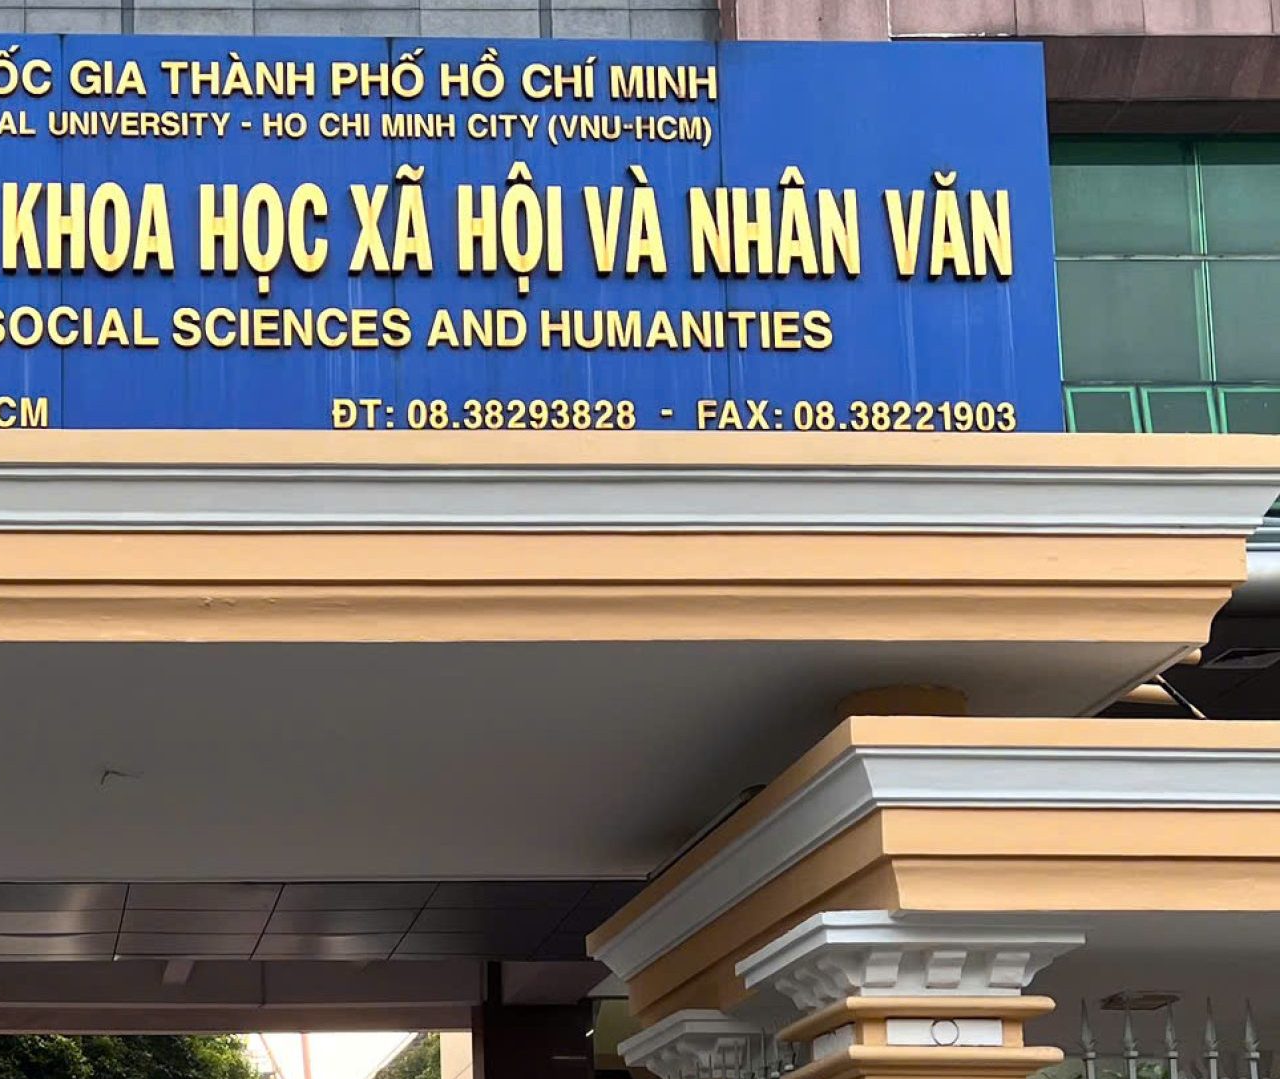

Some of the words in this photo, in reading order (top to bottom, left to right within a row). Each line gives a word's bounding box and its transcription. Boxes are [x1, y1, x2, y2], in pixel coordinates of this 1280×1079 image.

[70, 60, 147, 96] GIA
[161, 52, 315, 97] THÀNH
[331, 49, 425, 98] PHỐ
[440, 48, 505, 98] HỒ
[521, 56, 595, 99] CHÍ
[610, 65, 718, 100] MINH
[48, 111, 230, 138] UNIVERSITY
[263, 113, 308, 138] HO
[319, 112, 371, 138] CHI
[381, 114, 456, 139] MINH
[467, 113, 538, 140] CITY
[548, 115, 712, 146] (VNU-HCM)
[2, 182, 175, 273] KHOA
[199, 183, 329, 294] HỌC
[350, 164, 434, 273] XÃ
[457, 161, 564, 294] HỘI
[584, 165, 668, 274] VÀ
[689, 166, 861, 276] NHÂN
[884, 171, 1014, 277] VĂN
[173, 307, 412, 349] SCIENCES
[427, 309, 528, 349] AND
[540, 309, 834, 350] HUMANITIES
[406, 399, 637, 430] 08.38293828
[697, 399, 783, 430] FAX:
[793, 401, 1018, 432] 08.38221903
